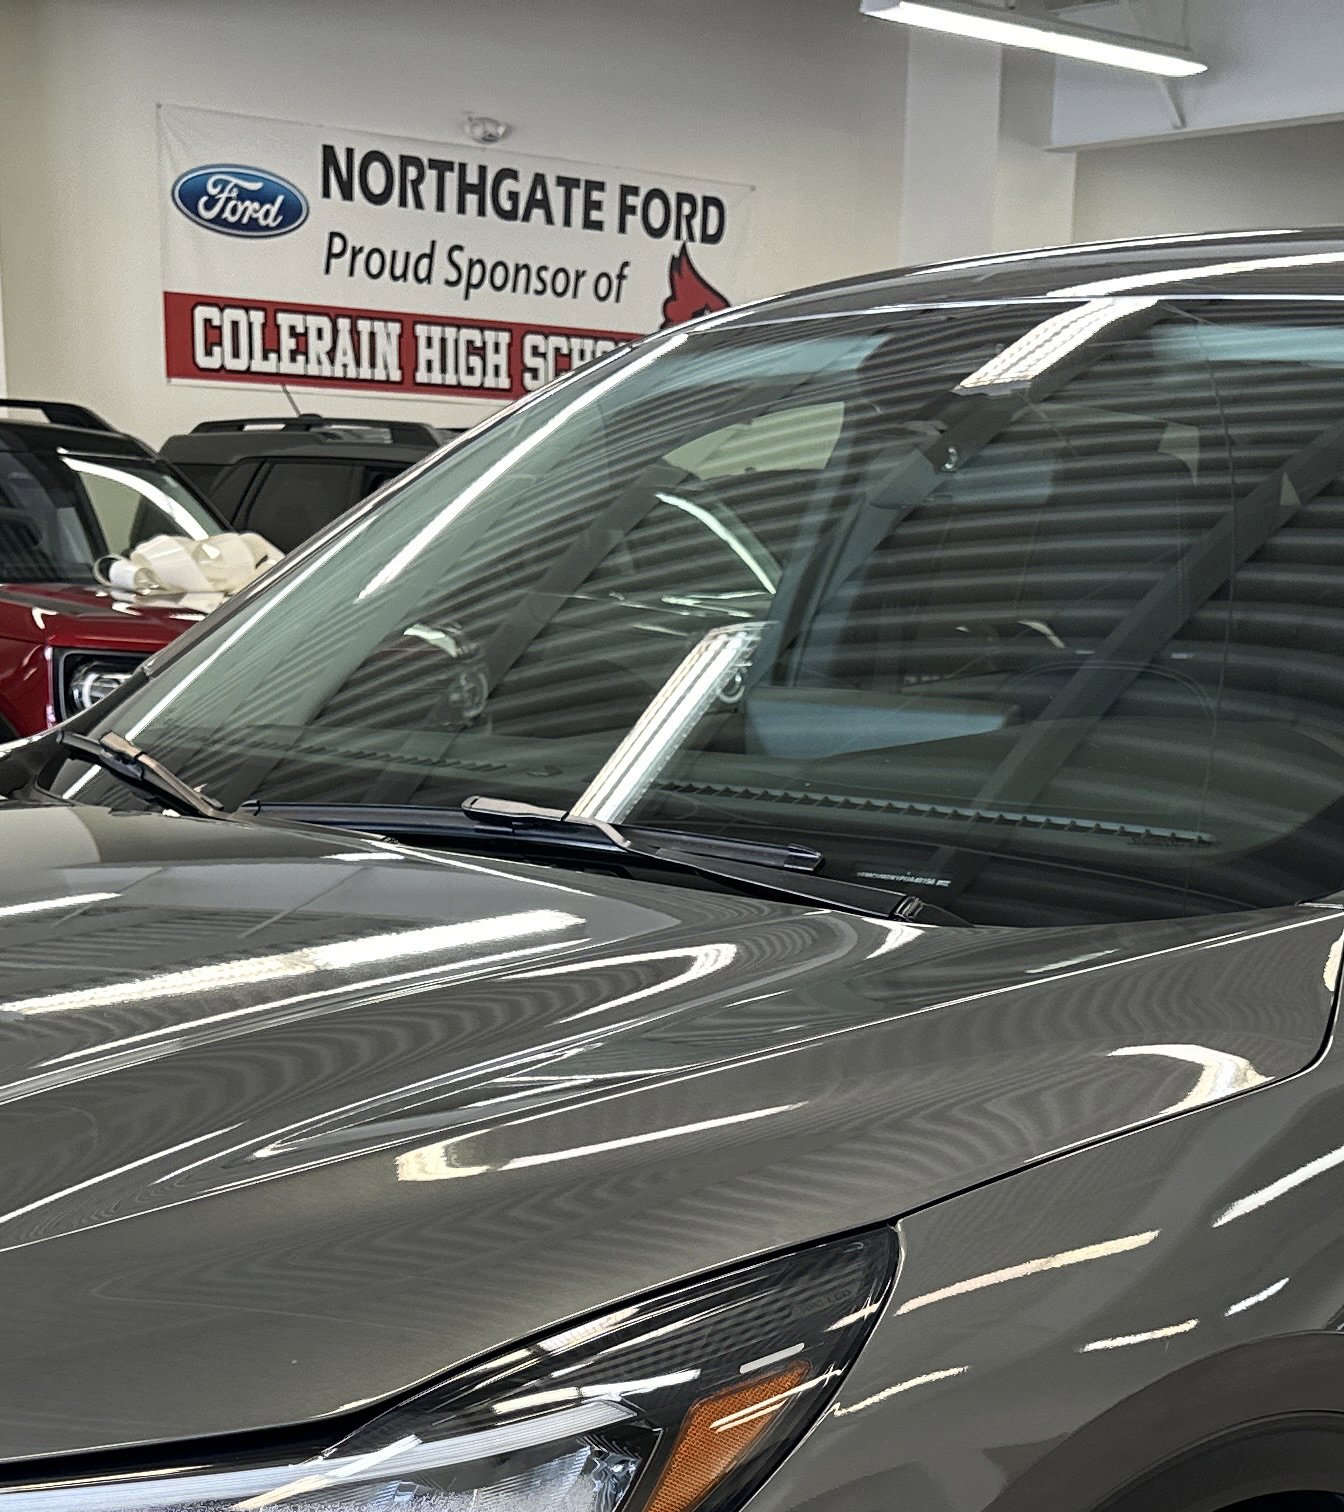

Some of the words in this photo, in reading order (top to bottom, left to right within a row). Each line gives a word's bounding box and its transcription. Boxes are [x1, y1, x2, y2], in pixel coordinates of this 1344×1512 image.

[197, 174, 285, 228] Ford
[321, 144, 606, 232] NORTHGATE
[617, 184, 726, 245] FORD
[324, 231, 437, 285] Proud
[444, 244, 587, 300] Sponsor
[593, 261, 631, 304] of
[192, 303, 403, 384] COLERAIN
[413, 322, 512, 391] HIGH
[521, 329, 628, 392] SCH
